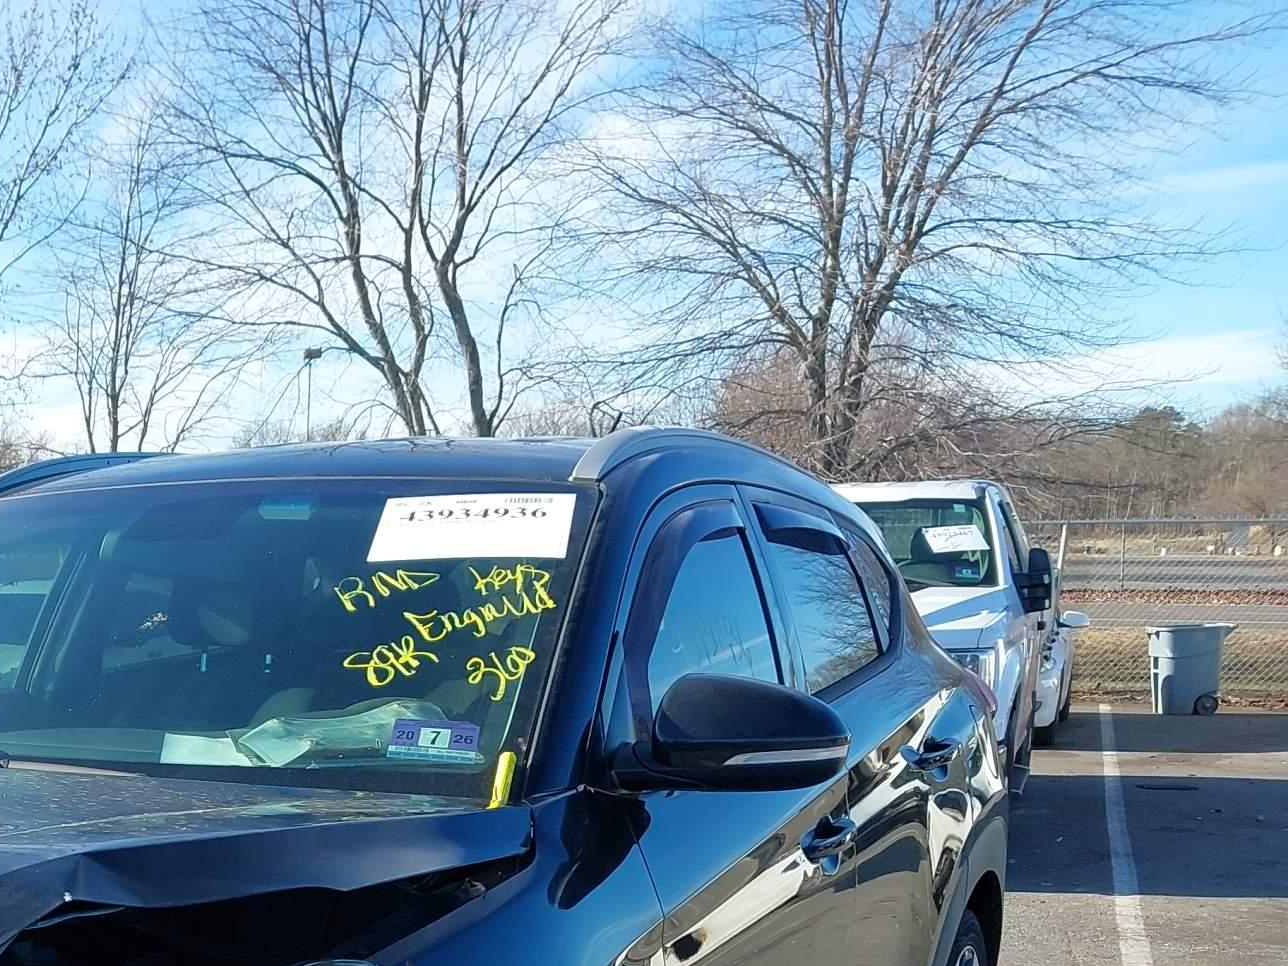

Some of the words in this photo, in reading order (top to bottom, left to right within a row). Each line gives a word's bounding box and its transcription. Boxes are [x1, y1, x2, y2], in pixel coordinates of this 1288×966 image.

[399, 506, 548, 522] 43934936
[396, 730, 415, 741] 20
[429, 730, 442, 746] 7
[453, 734, 474, 745] 26
